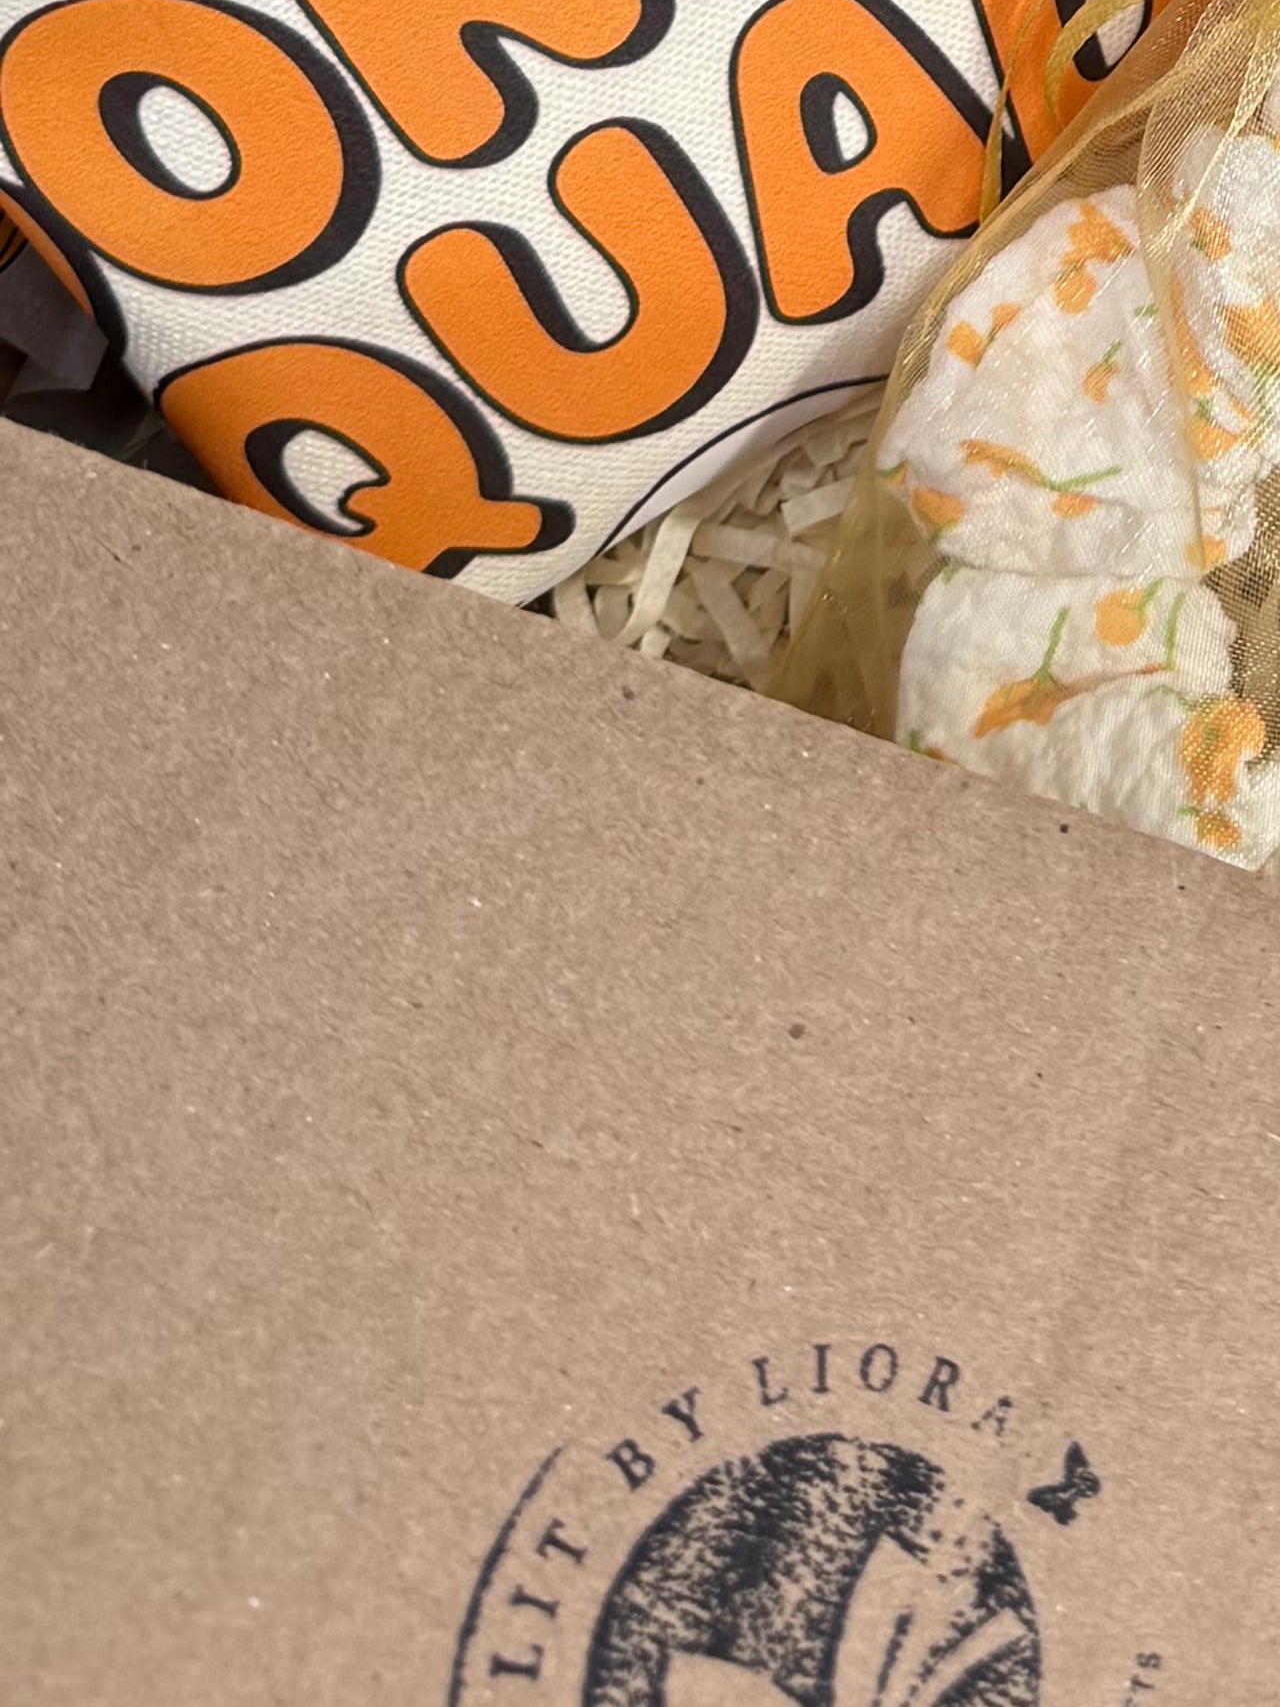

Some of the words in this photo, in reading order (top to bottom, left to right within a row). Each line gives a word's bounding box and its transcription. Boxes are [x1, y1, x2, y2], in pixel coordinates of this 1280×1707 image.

[489, 1518, 594, 1683] LIT
[605, 1386, 705, 1491] BY
[752, 1342, 1018, 1436] LIORA
